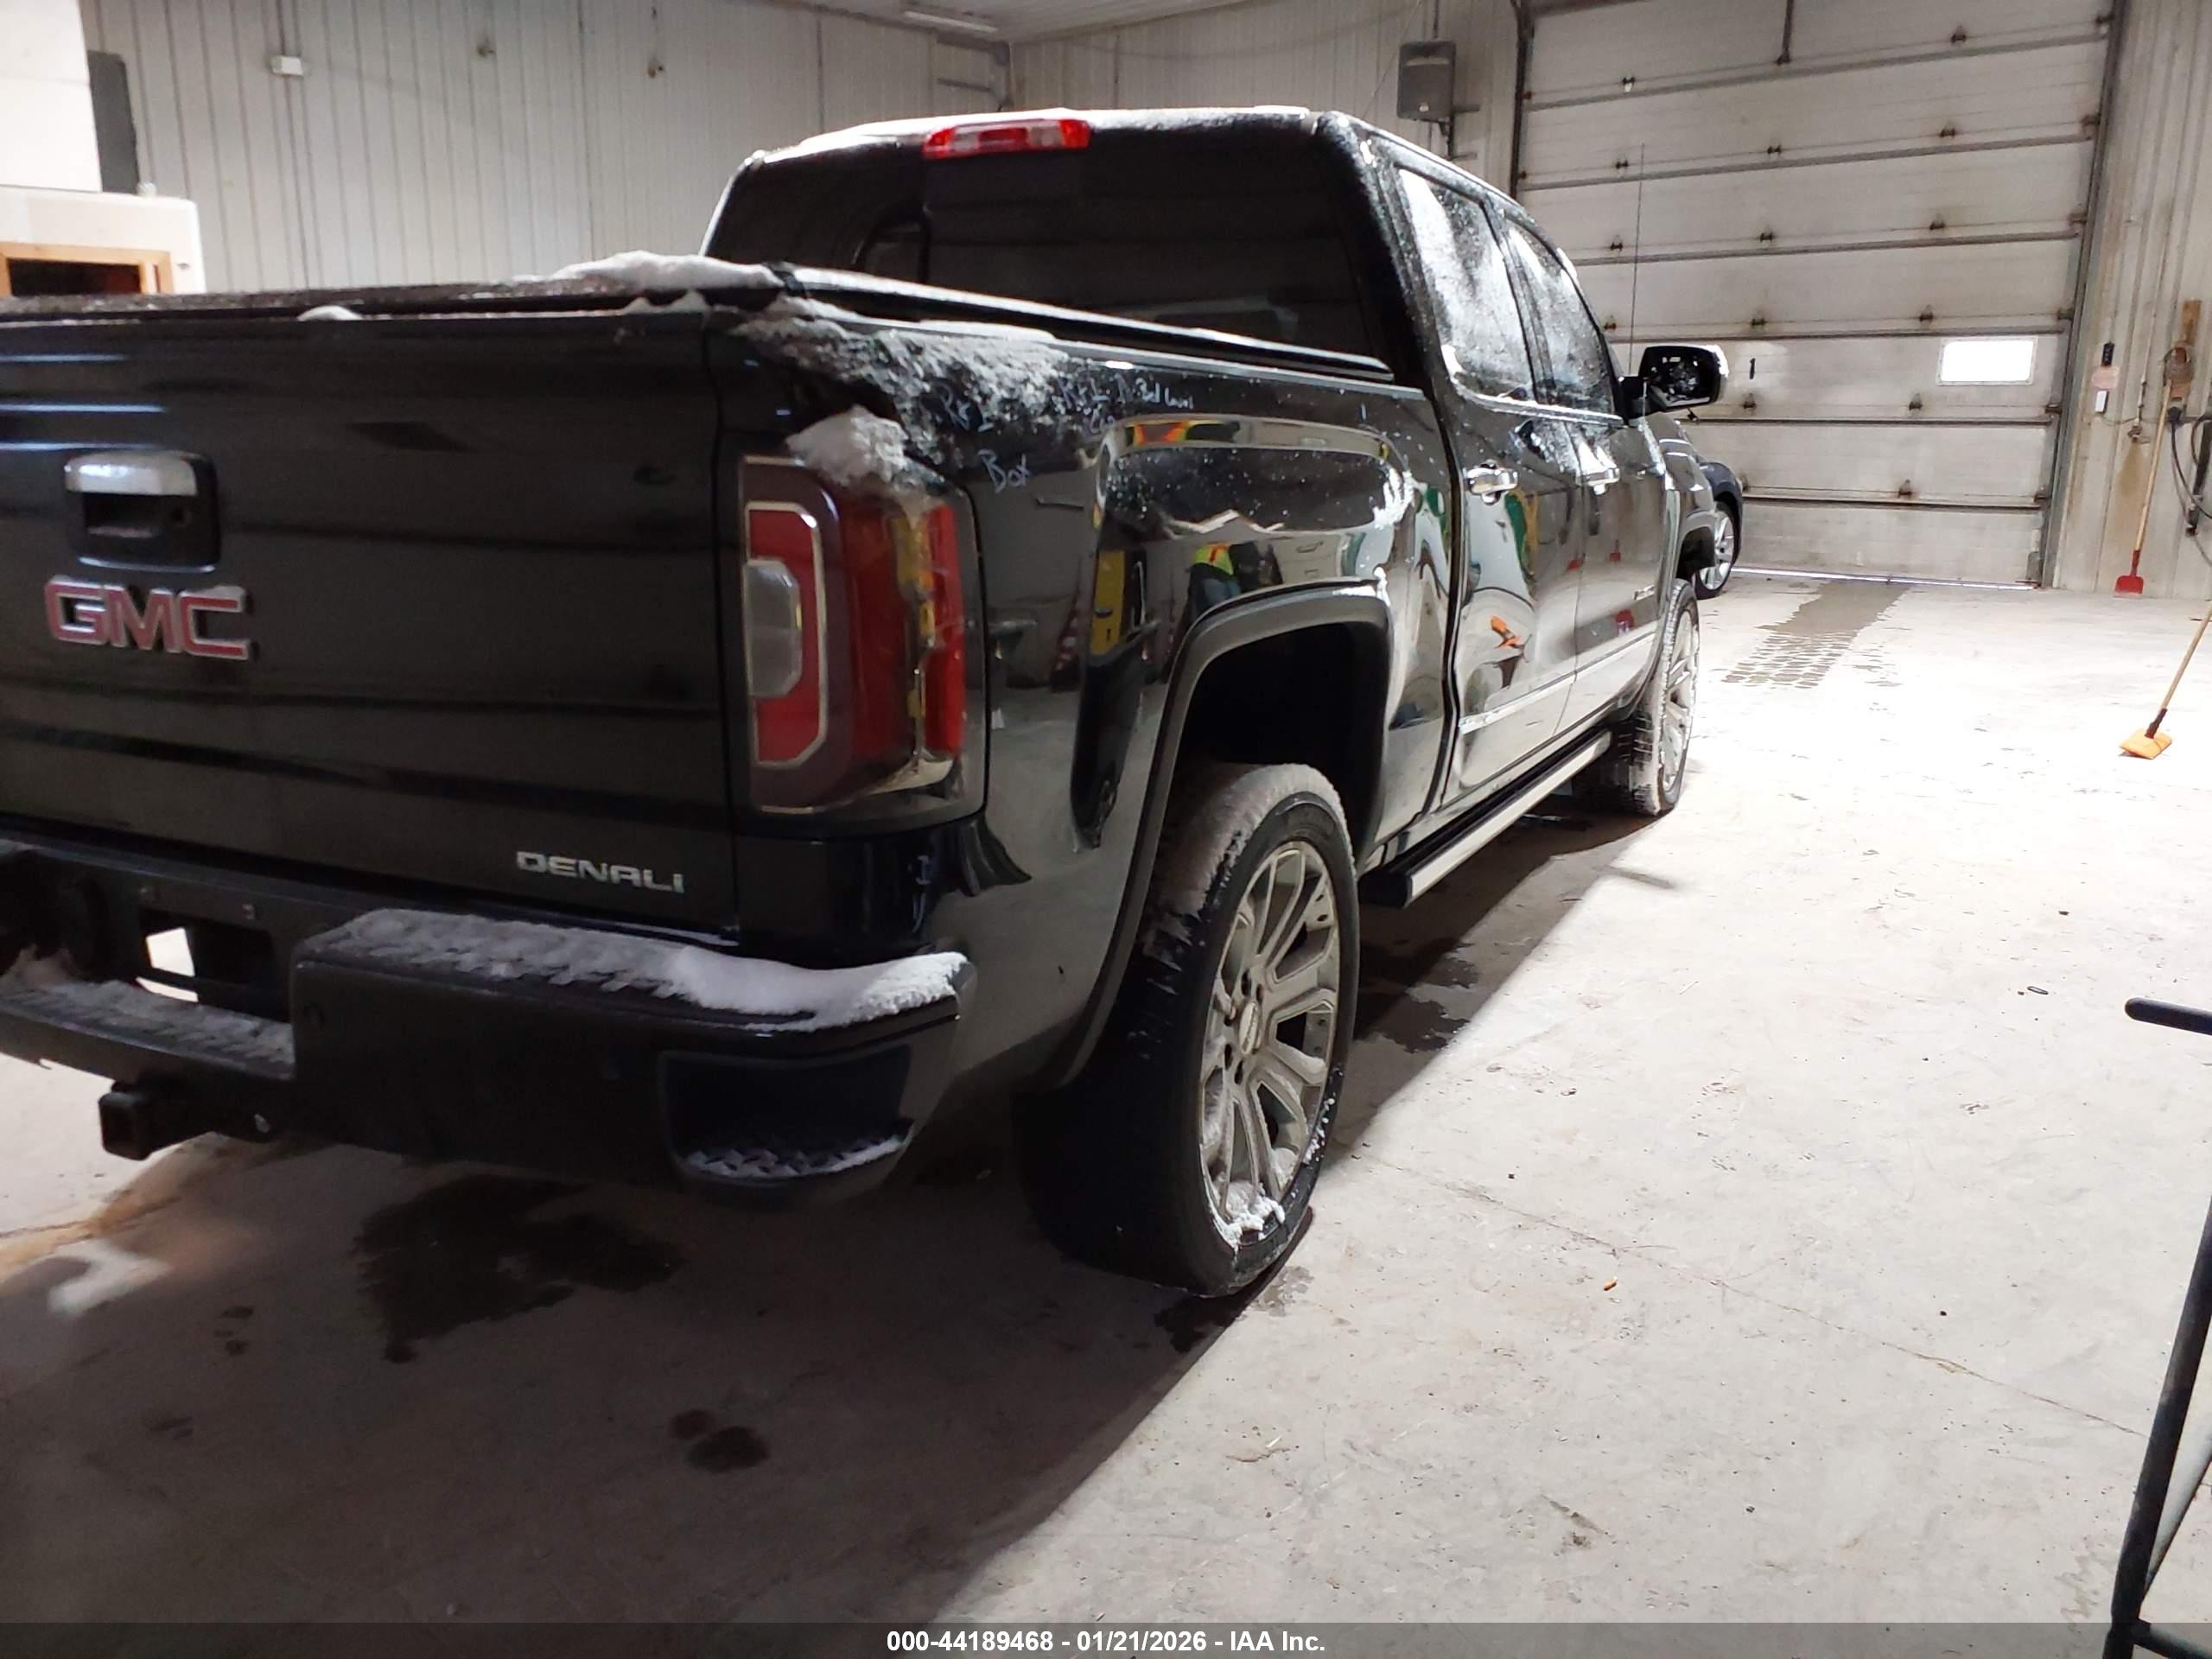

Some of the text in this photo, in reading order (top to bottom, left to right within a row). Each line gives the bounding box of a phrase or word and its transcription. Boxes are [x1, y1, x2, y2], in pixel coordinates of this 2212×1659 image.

[1748, 357, 1757, 380] 1
[44, 577, 250, 661] GMC
[516, 850, 685, 893] DENALI
